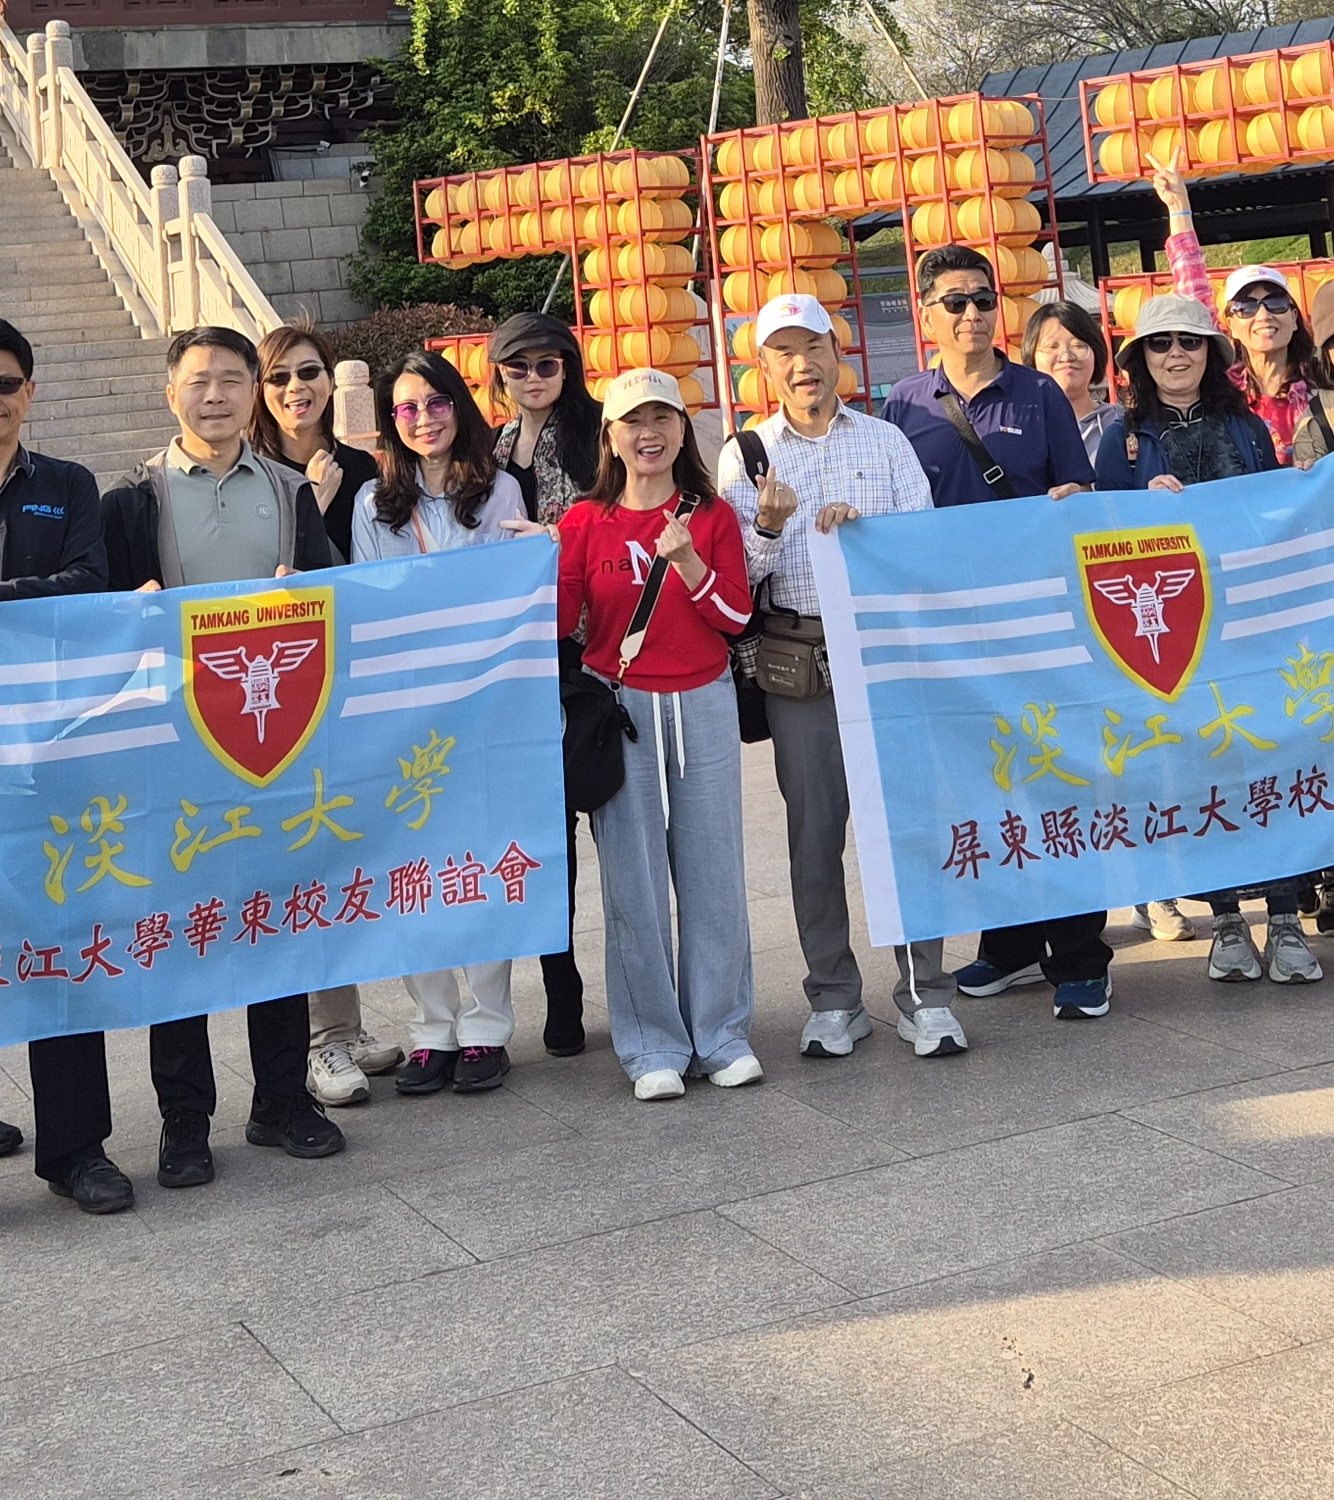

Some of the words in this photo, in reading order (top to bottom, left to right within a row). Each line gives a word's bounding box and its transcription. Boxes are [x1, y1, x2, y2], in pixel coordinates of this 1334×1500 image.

[1082, 540, 1133, 561] TAMKANG
[1137, 535, 1192, 554] UNIVERSITY
[190, 609, 250, 631] TAMKANG
[256, 600, 326, 623] UNIVERSITY
